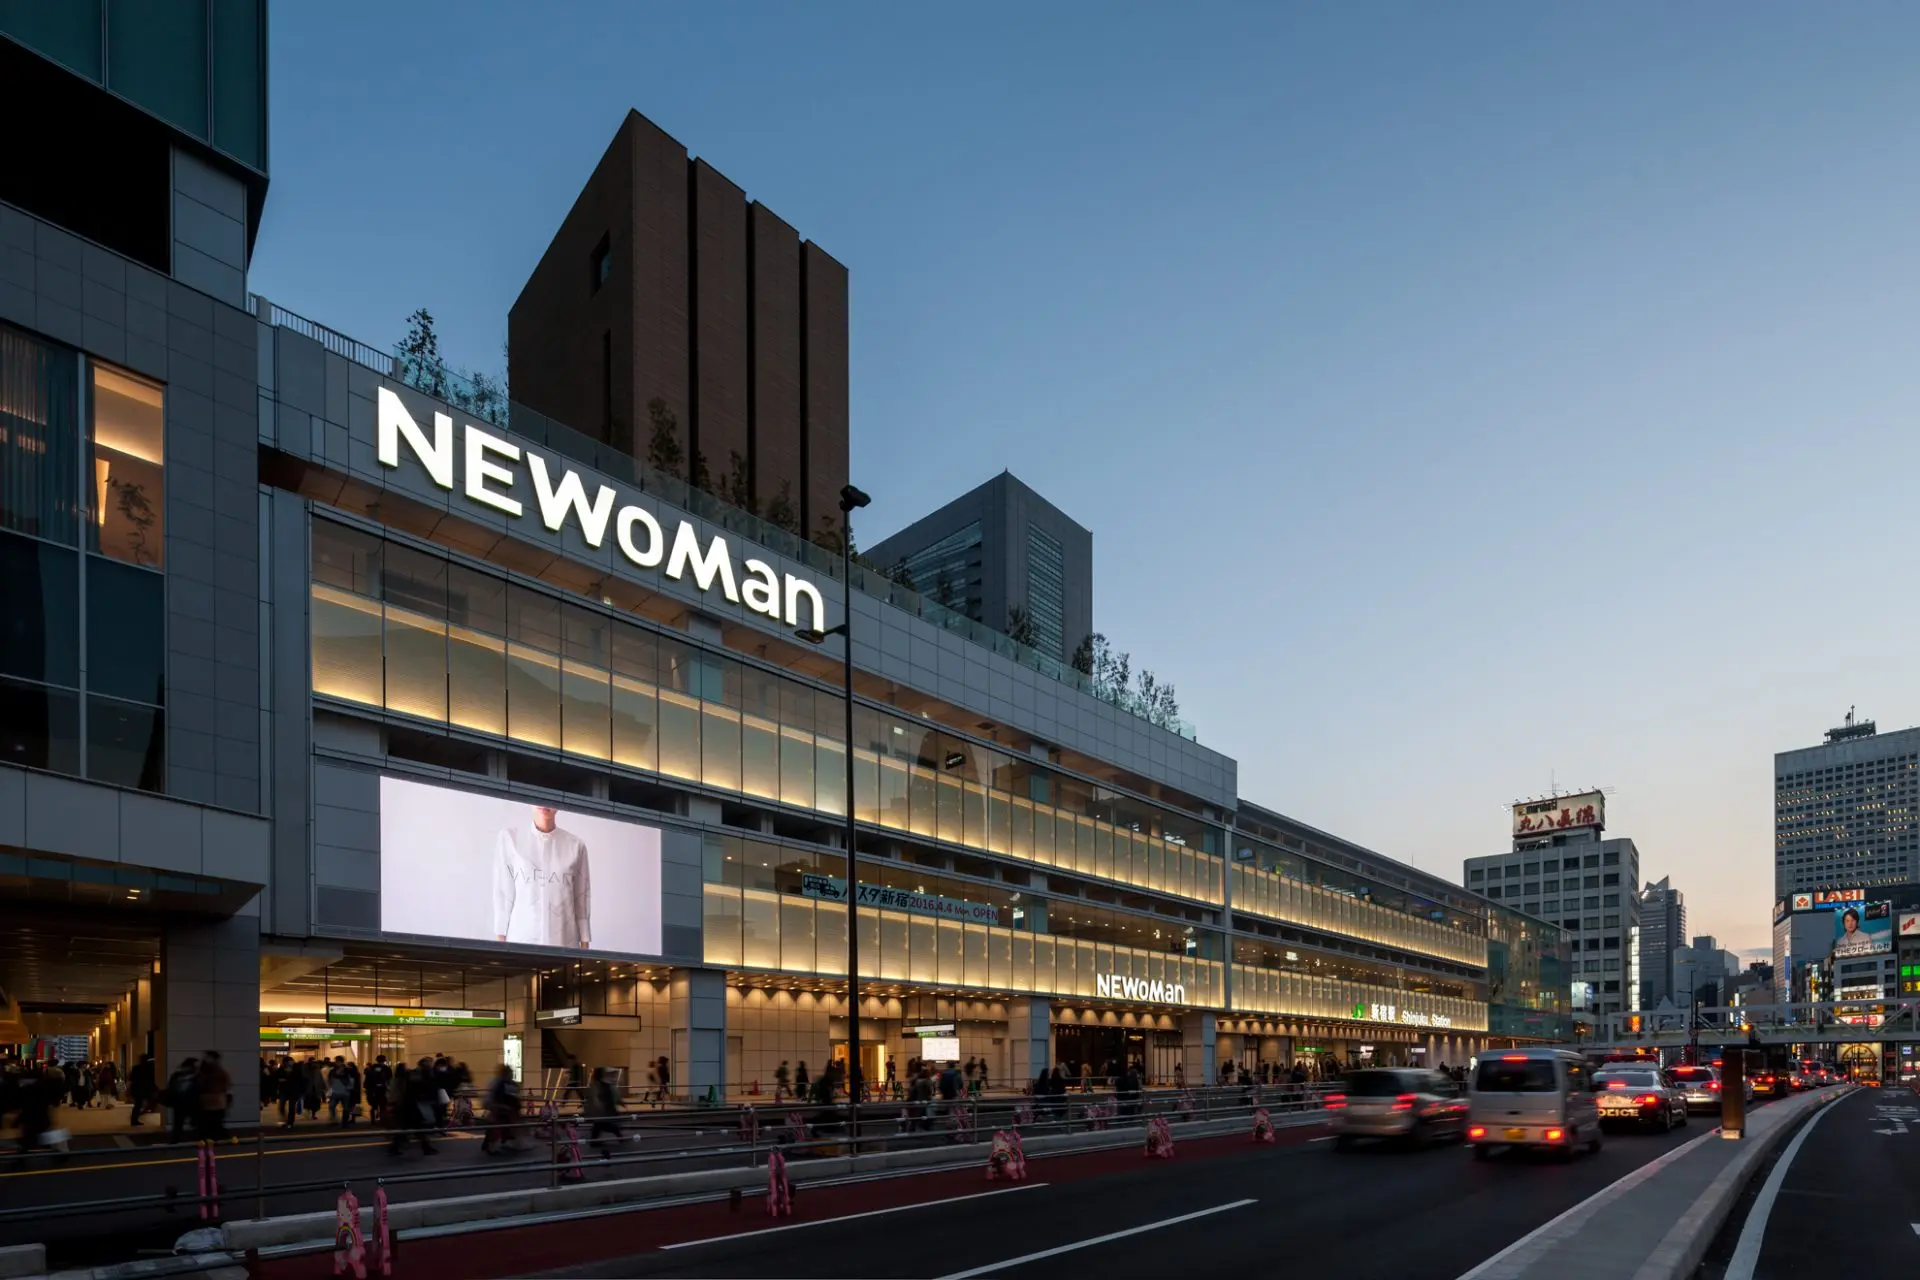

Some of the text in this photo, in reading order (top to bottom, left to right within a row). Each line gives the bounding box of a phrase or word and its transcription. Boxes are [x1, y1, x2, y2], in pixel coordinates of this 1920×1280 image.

[377, 386, 825, 633] NEWoMan
[1518, 804, 1595, 832] 丸八真綿
[1815, 889, 1865, 903] LABI
[973, 907, 998, 920] OPEN
[1097, 973, 1185, 1004] NEWoMan
